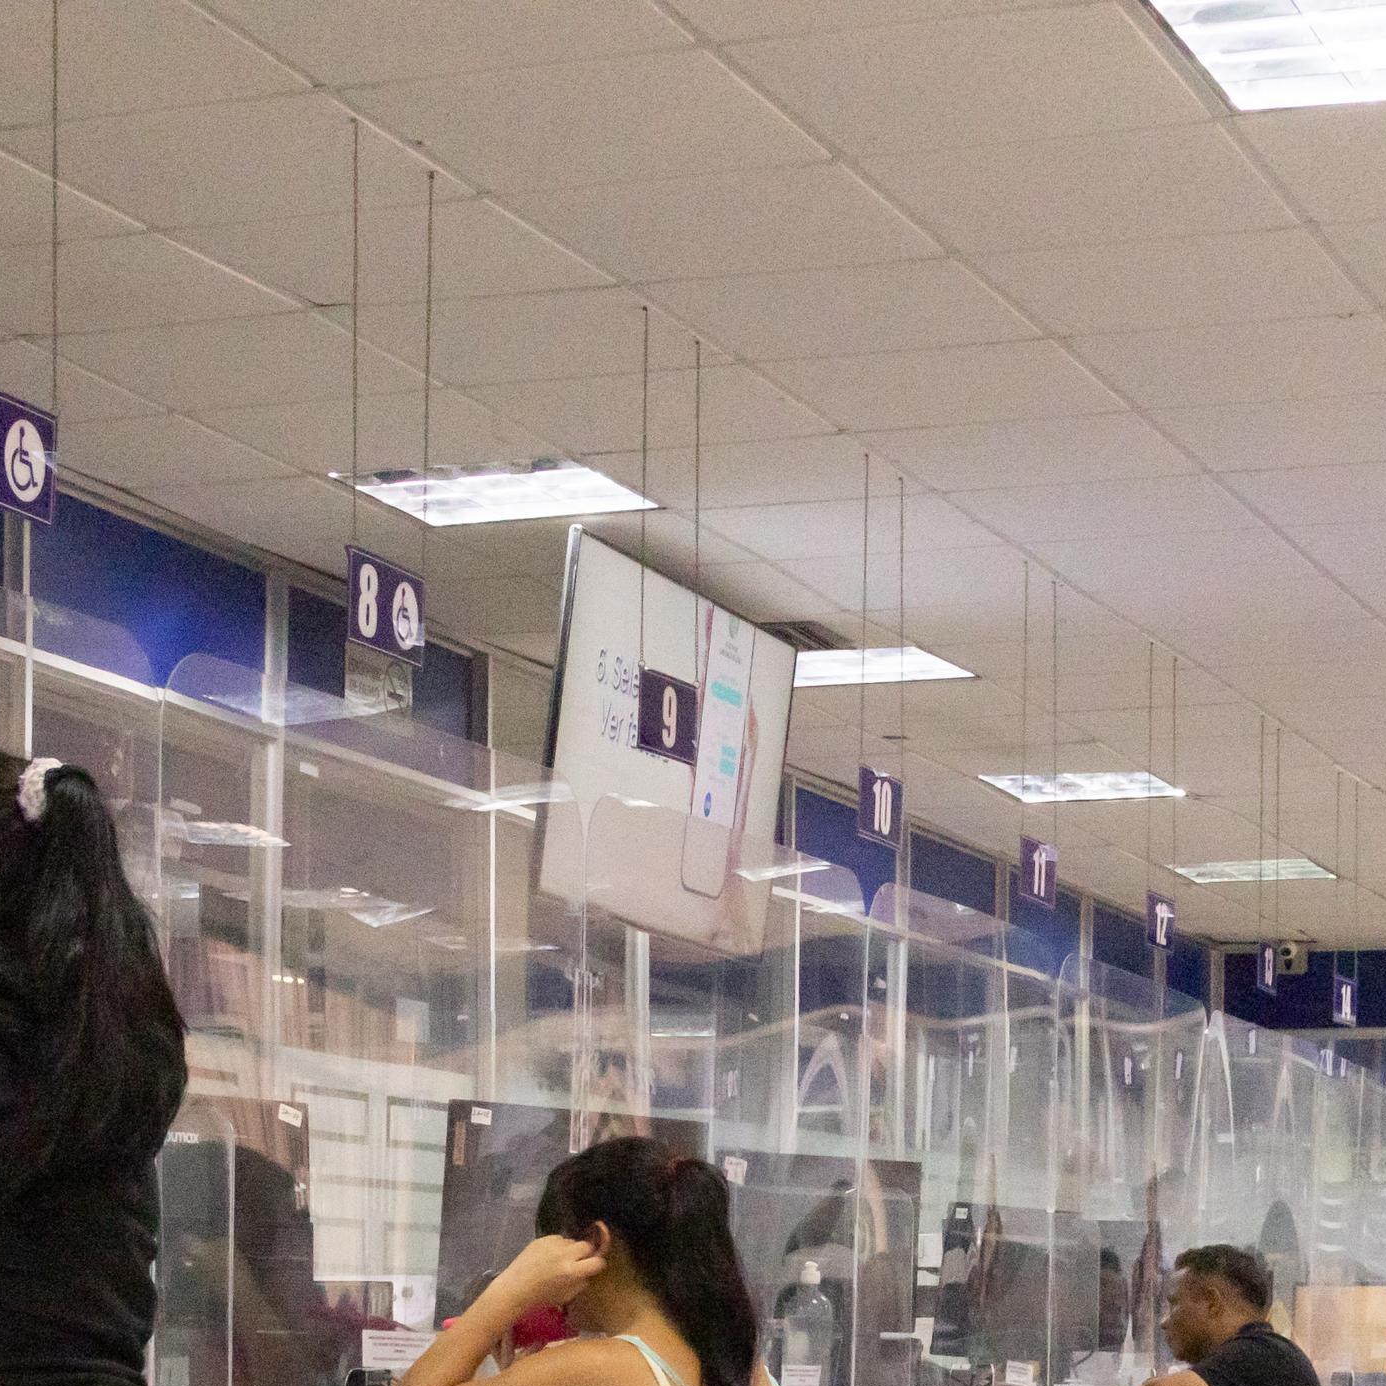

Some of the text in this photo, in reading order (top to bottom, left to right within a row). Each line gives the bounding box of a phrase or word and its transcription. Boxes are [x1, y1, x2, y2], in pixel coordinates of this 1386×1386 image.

[358, 563, 379, 638] 8
[662, 685, 677, 748] 9
[873, 777, 892, 835] 10
[1033, 847, 1046, 898] 11
